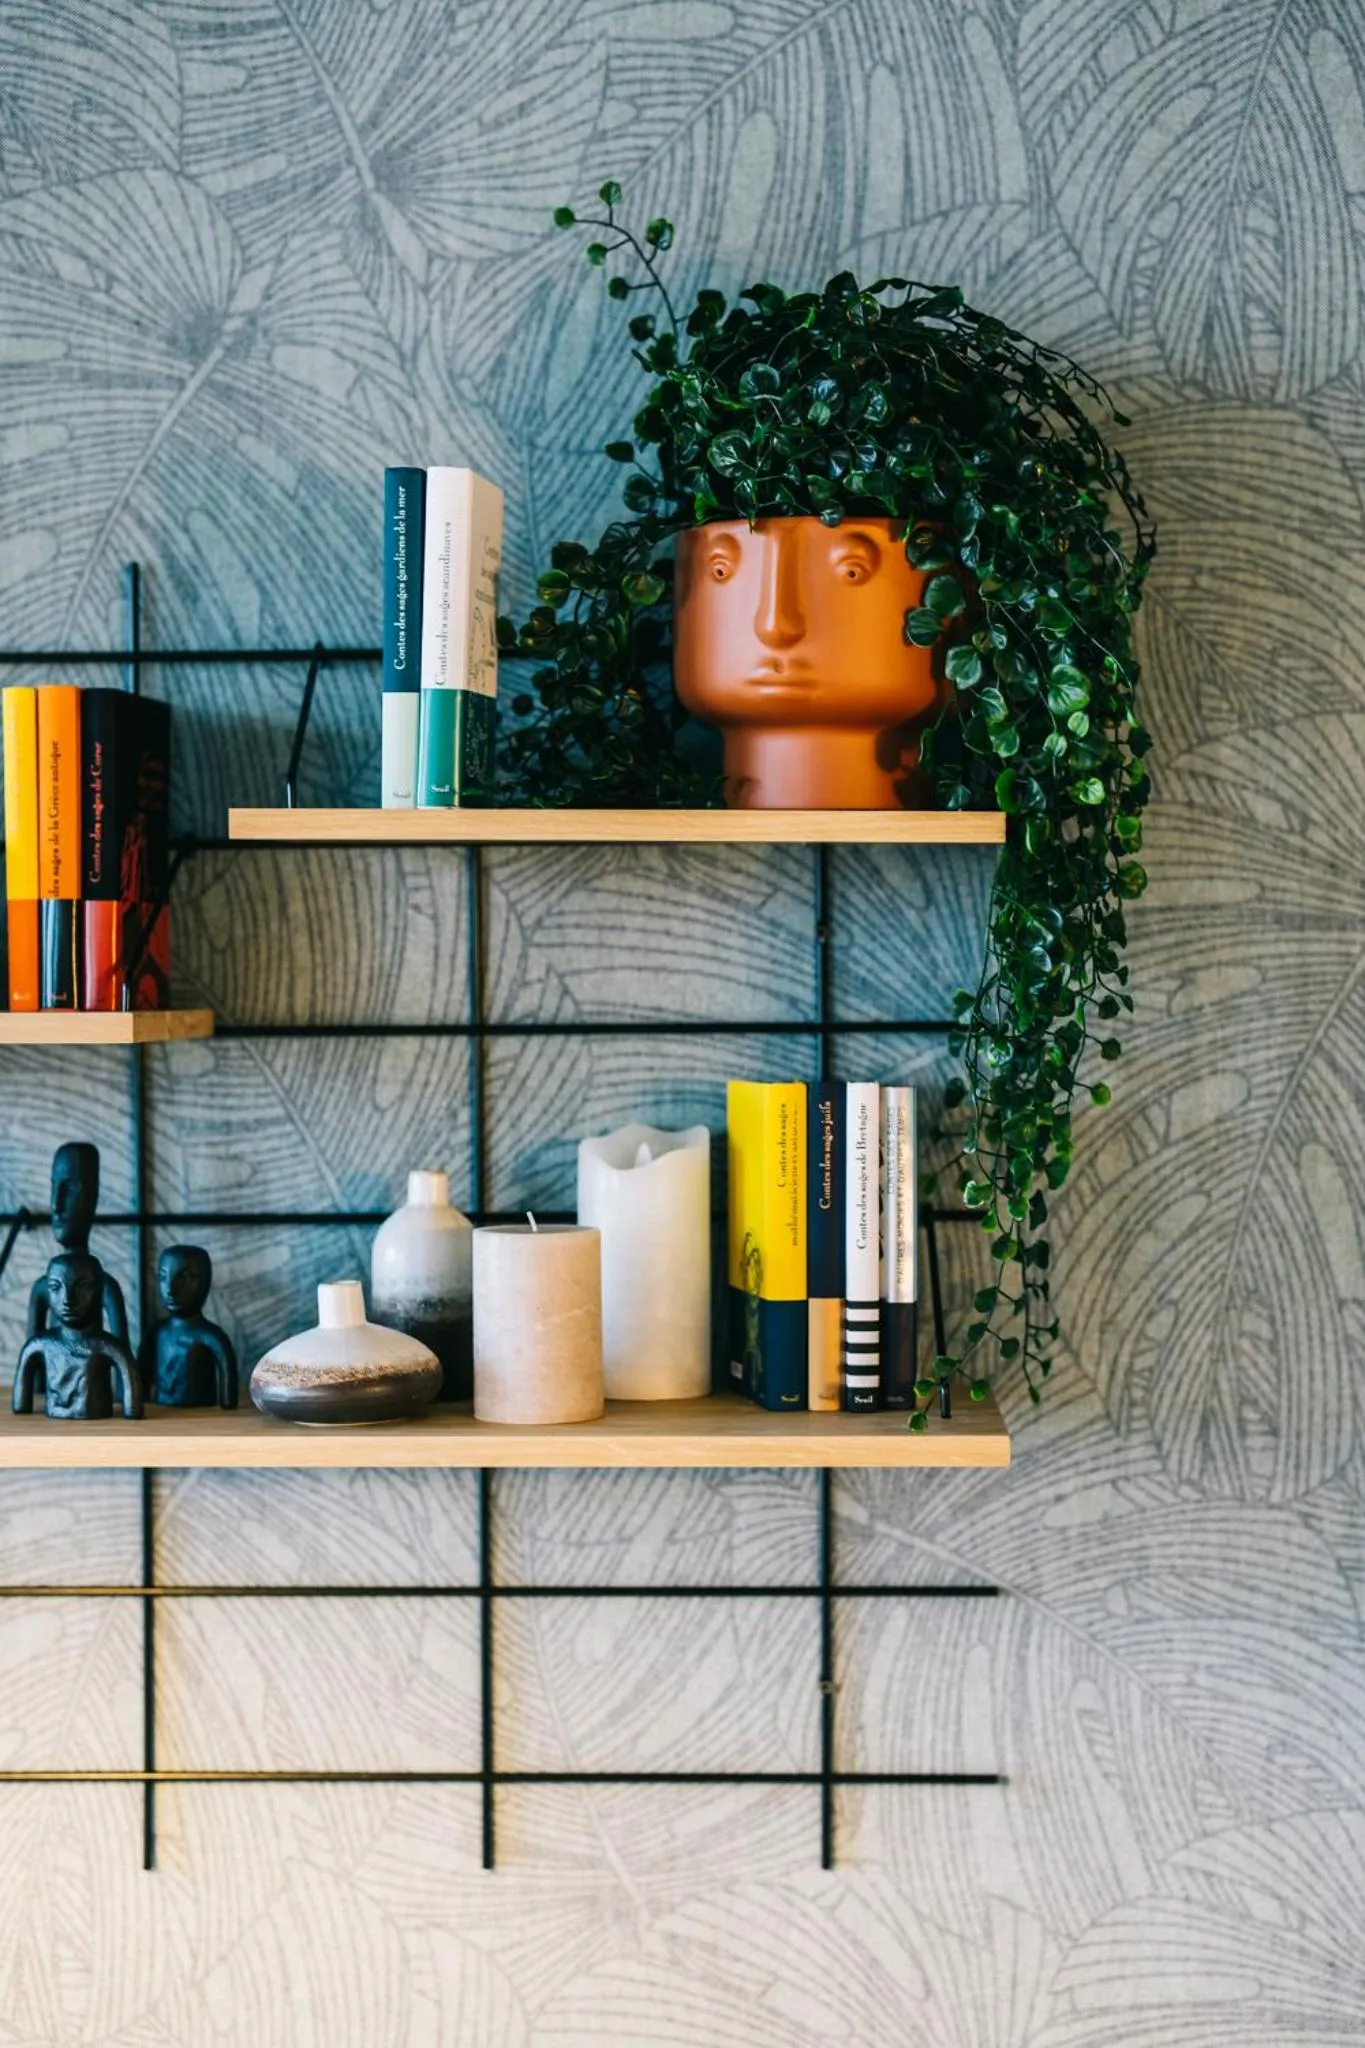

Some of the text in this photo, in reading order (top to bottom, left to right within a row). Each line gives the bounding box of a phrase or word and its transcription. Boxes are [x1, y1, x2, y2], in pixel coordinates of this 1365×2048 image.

[393, 486, 409, 671] Contes des sages gardiens de la mer
[439, 591, 451, 621] sages
[434, 644, 448, 687] Contes
[436, 623, 449, 643] des
[776, 1103, 789, 1188] Contes des sages
[817, 1101, 835, 1210] Contes des sages juifs
[855, 1103, 869, 1250] Contes des sages de Bretagne
